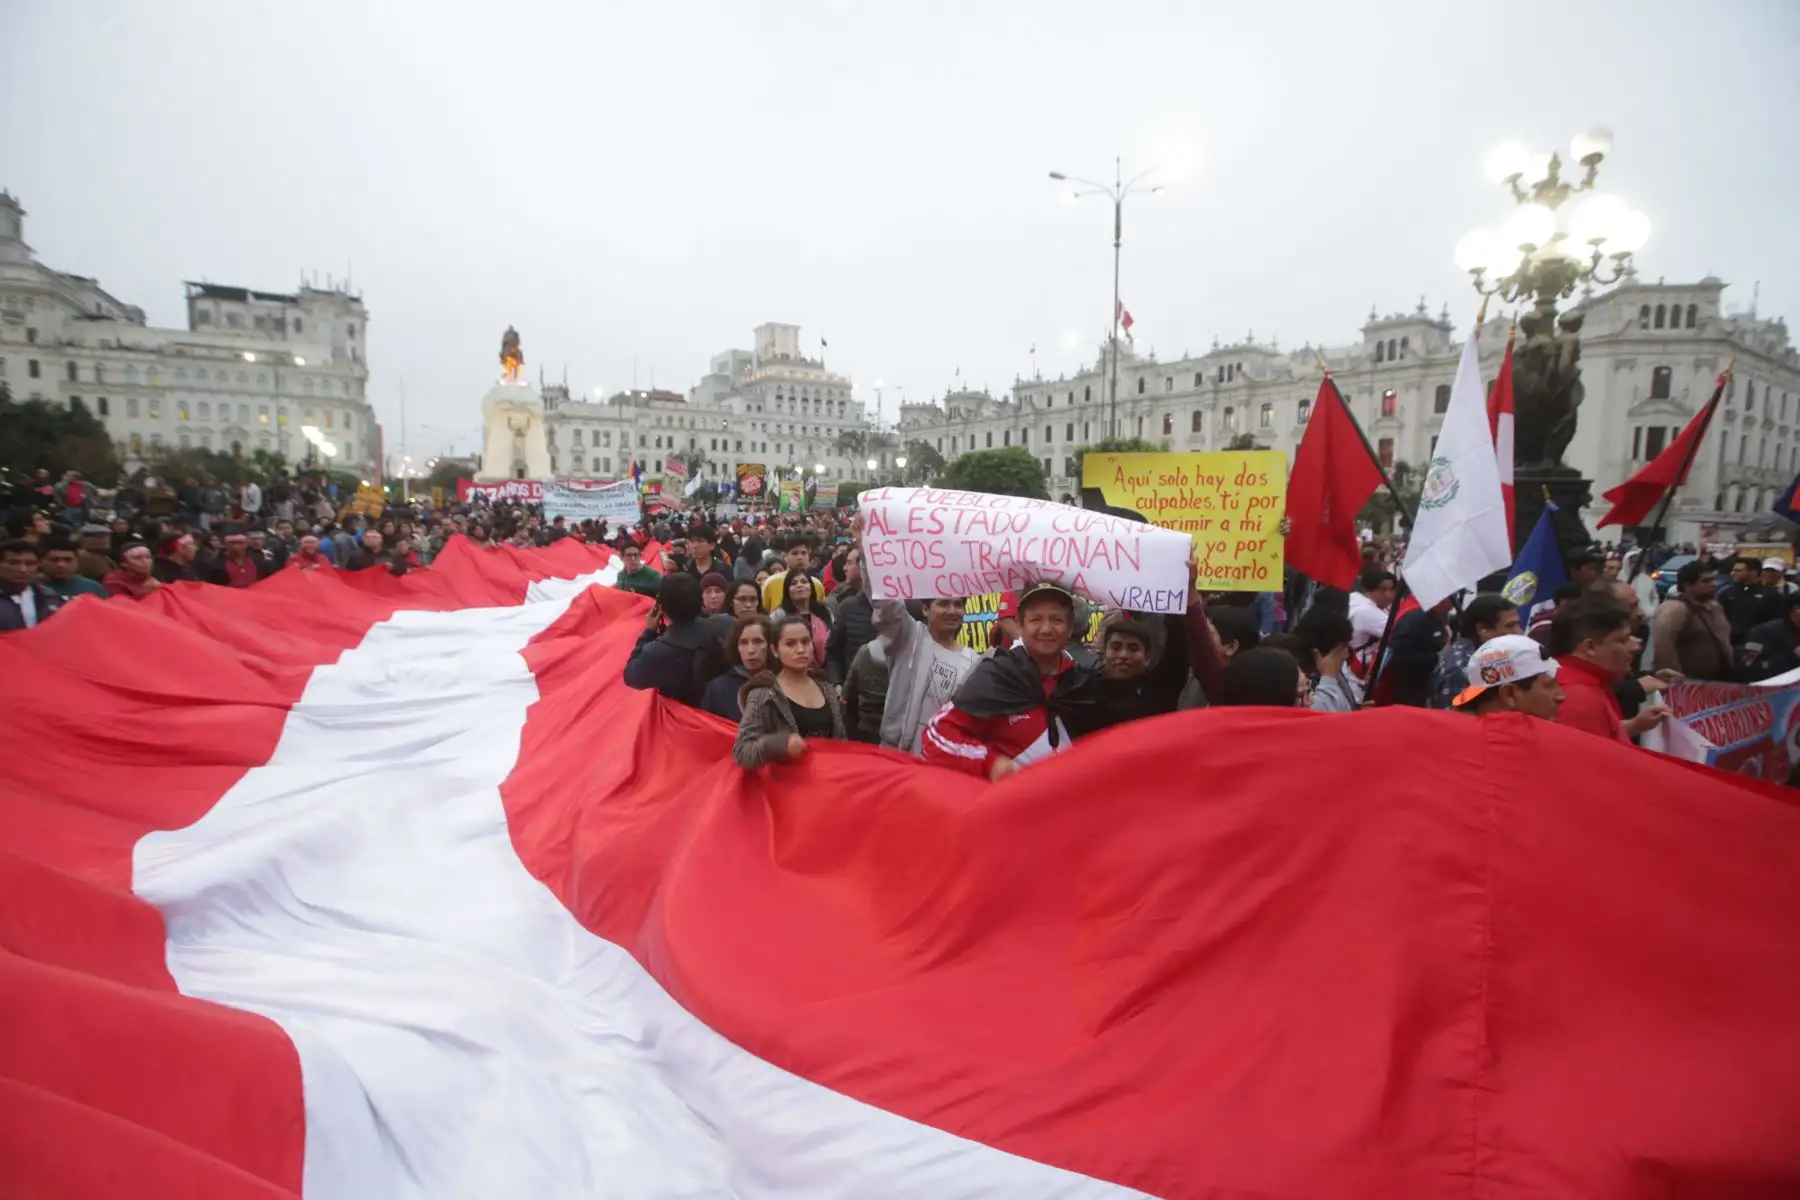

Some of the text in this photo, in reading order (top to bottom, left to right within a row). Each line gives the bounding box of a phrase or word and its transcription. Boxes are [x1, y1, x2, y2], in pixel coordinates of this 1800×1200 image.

[1158, 466, 1189, 487] solo
[1195, 464, 1225, 492] hay
[1234, 461, 1268, 487] dos
[907, 488, 1011, 508] PUEBLO
[1135, 487, 1280, 521] culpables, tú por
[866, 506, 898, 537] AL
[908, 506, 1031, 536] ESTADO
[1220, 519, 1230, 532] a
[1240, 515, 1263, 532] mi
[869, 535, 1141, 572] ESTOS TRAICIONAN
[1206, 540, 1227, 560] yo
[1234, 537, 1268, 561] por
[882, 567, 1093, 600] SU CONFIANZA
[1108, 586, 1185, 612] VRAEM
